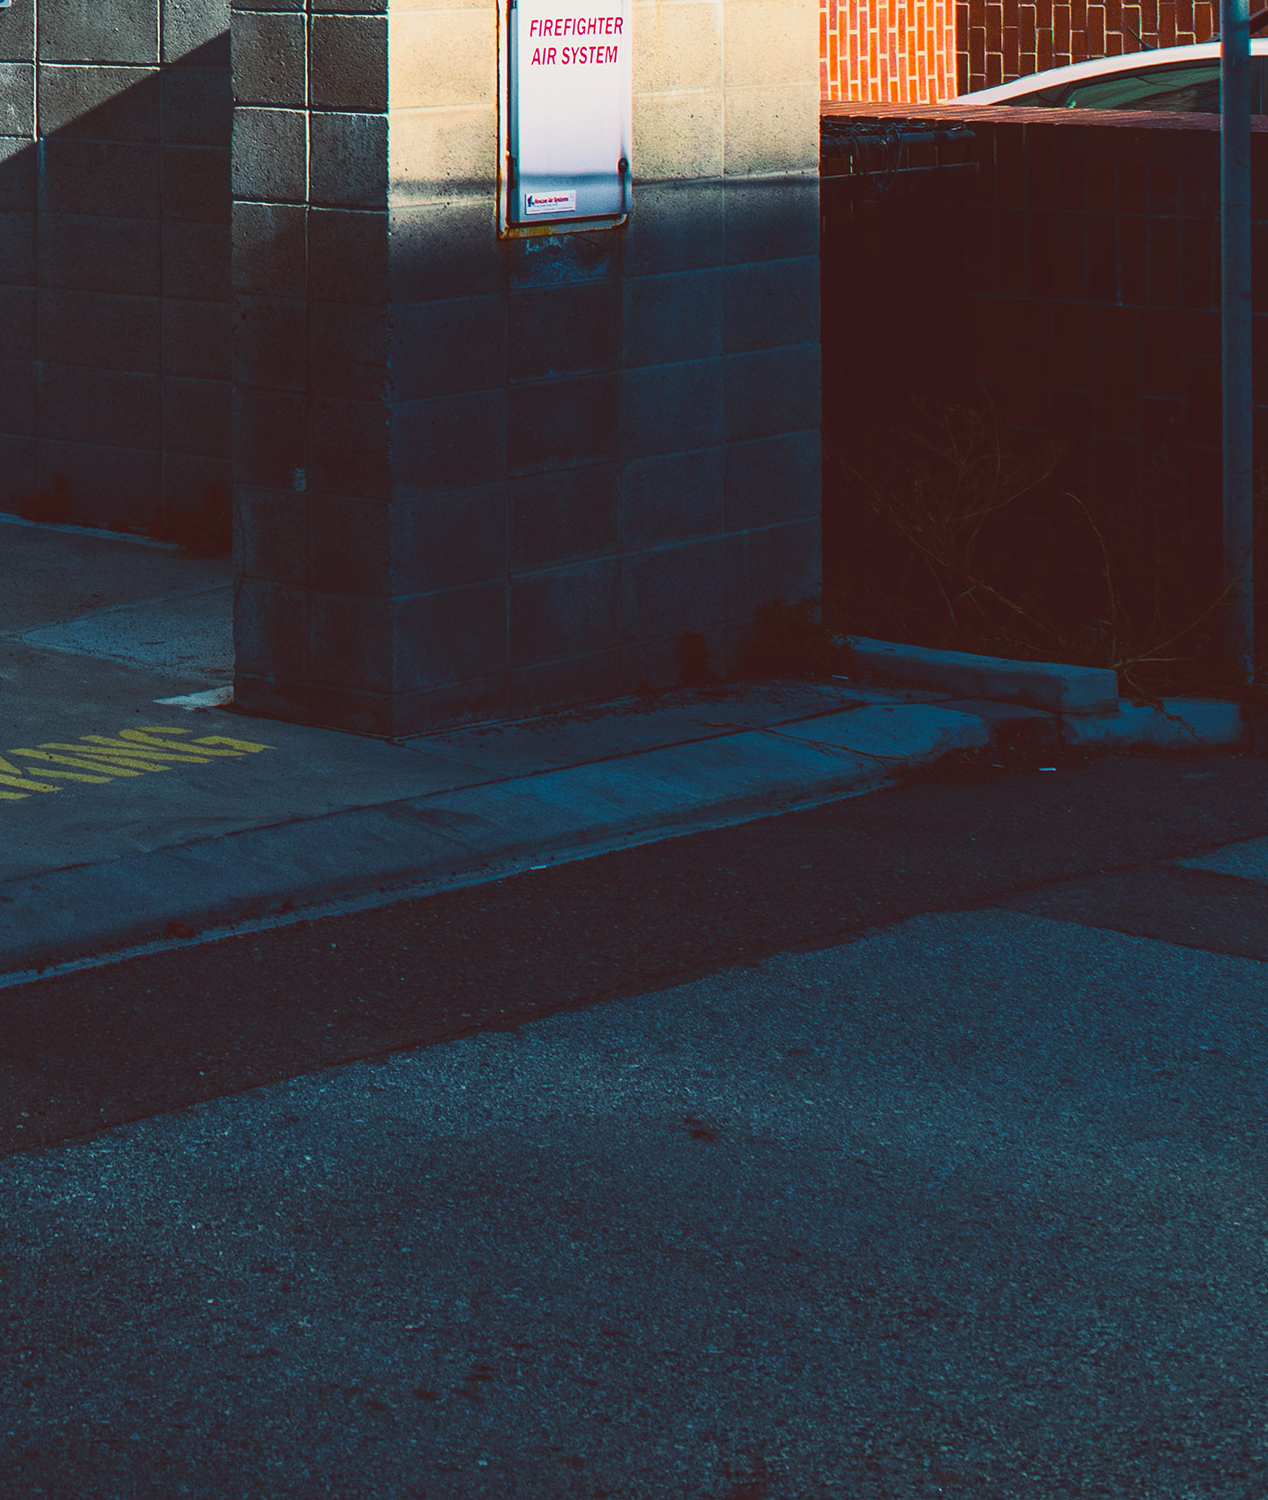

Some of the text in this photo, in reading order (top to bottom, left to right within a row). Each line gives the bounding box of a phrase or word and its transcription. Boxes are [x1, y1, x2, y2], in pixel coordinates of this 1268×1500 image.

[529, 16, 623, 37] FIREFIGHTER
[531, 45, 618, 66] AIR SYSTEM
